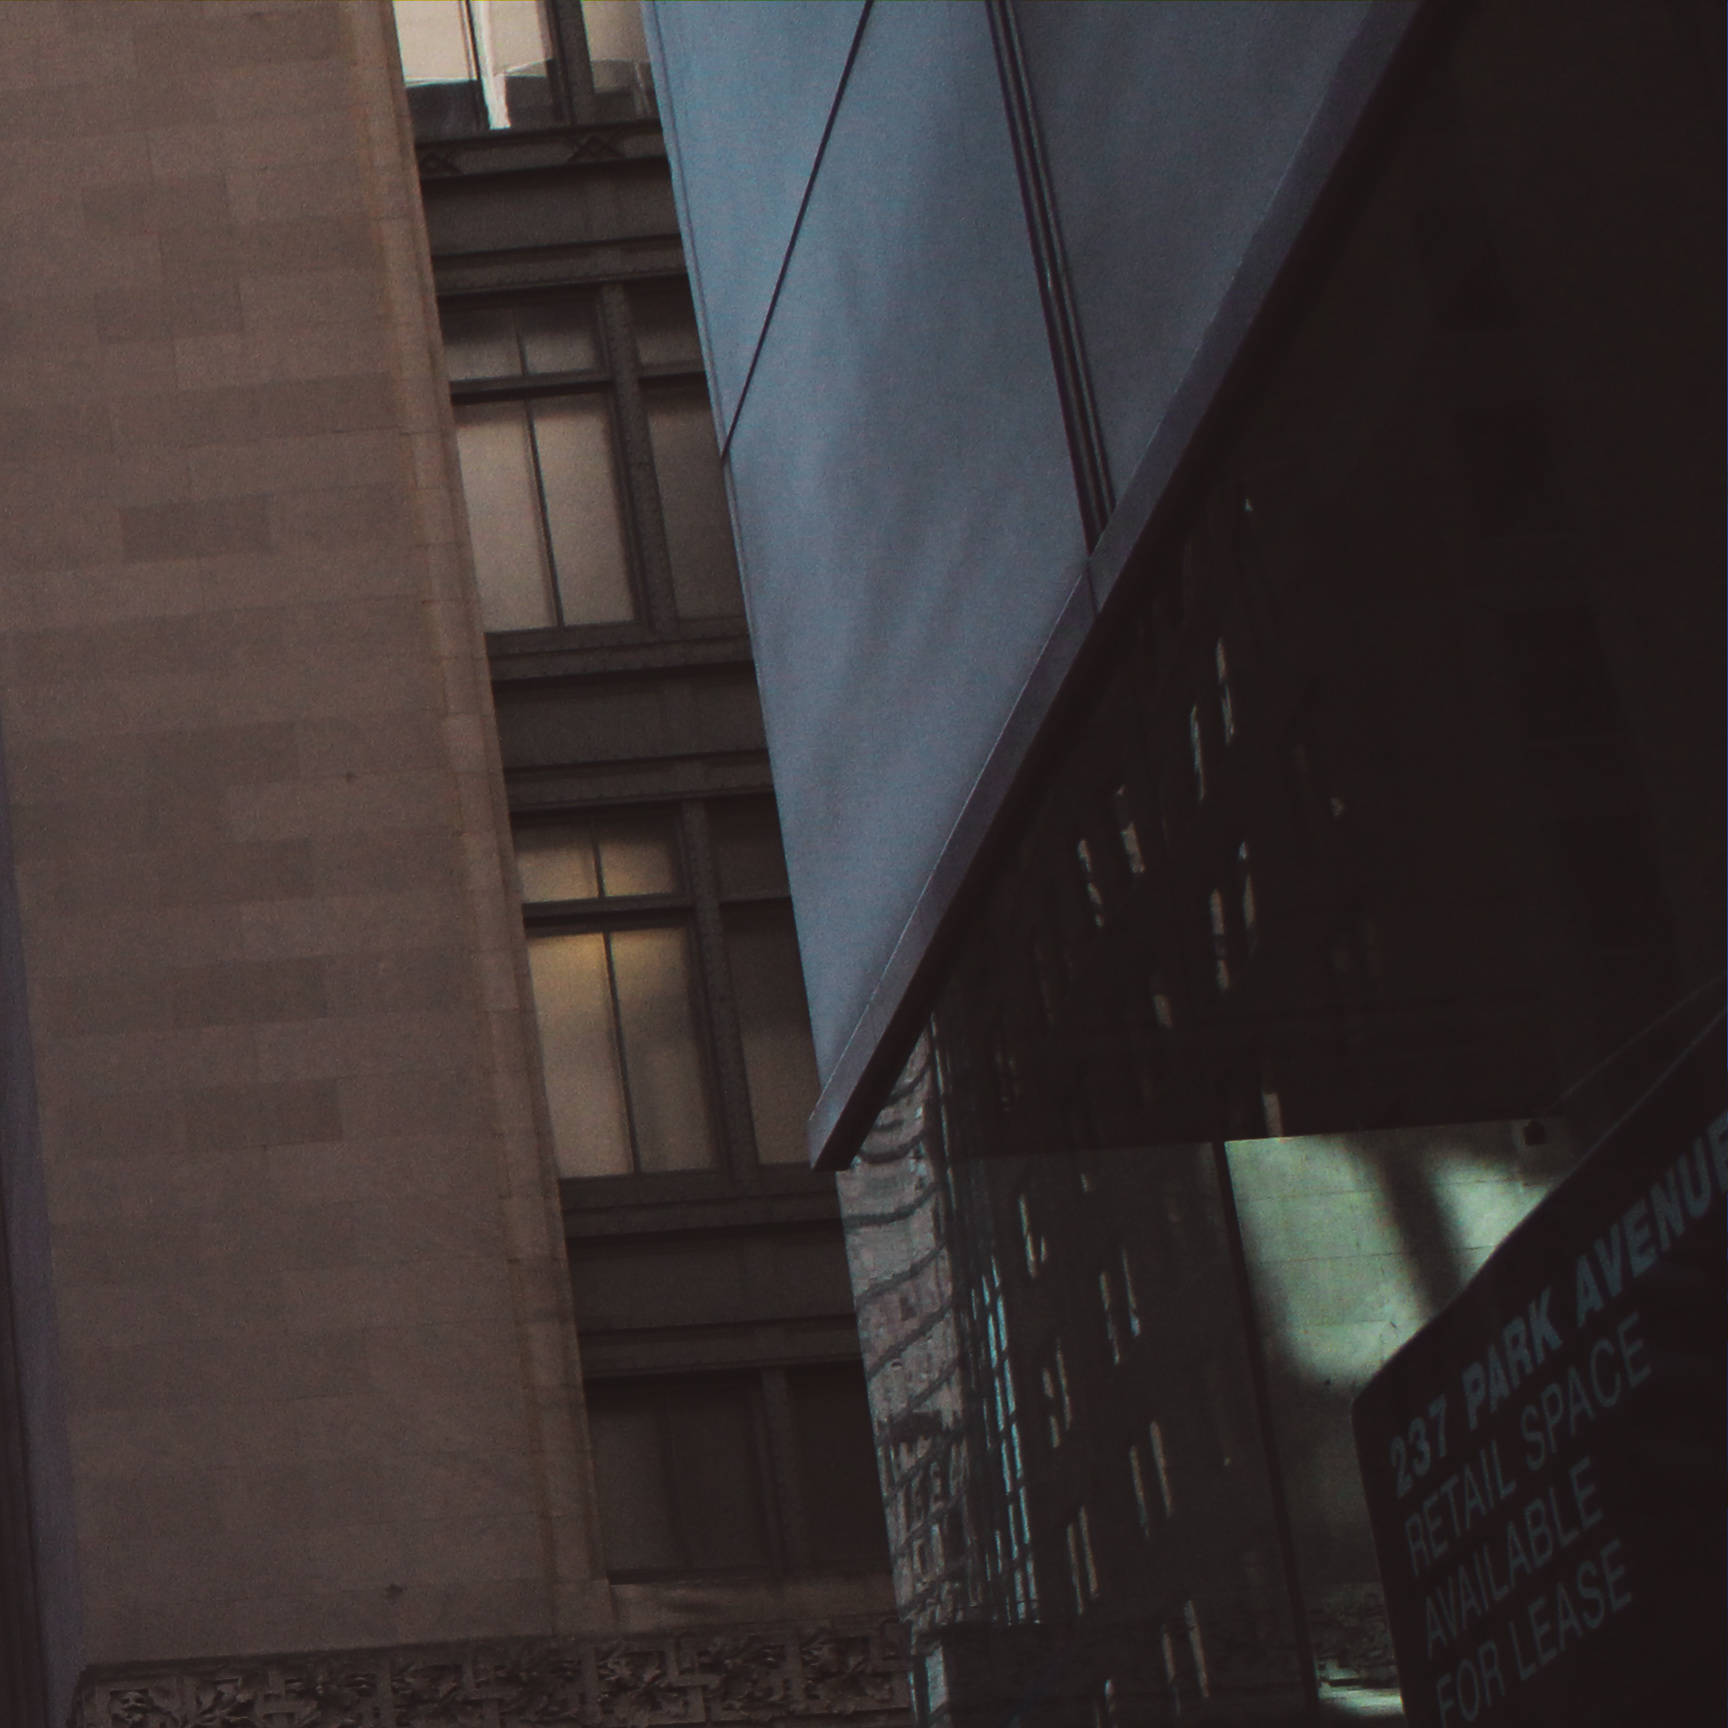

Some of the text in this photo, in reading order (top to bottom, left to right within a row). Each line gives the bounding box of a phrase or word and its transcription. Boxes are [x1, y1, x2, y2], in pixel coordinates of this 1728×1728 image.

[1387, 1392, 1450, 1501] 237
[1462, 1283, 1565, 1427] PARK
[1402, 1311, 1655, 1578] RETAIL SPACE
[1423, 1454, 1606, 1661] AVAILABLE
[1509, 1537, 1635, 1684] LEASE
